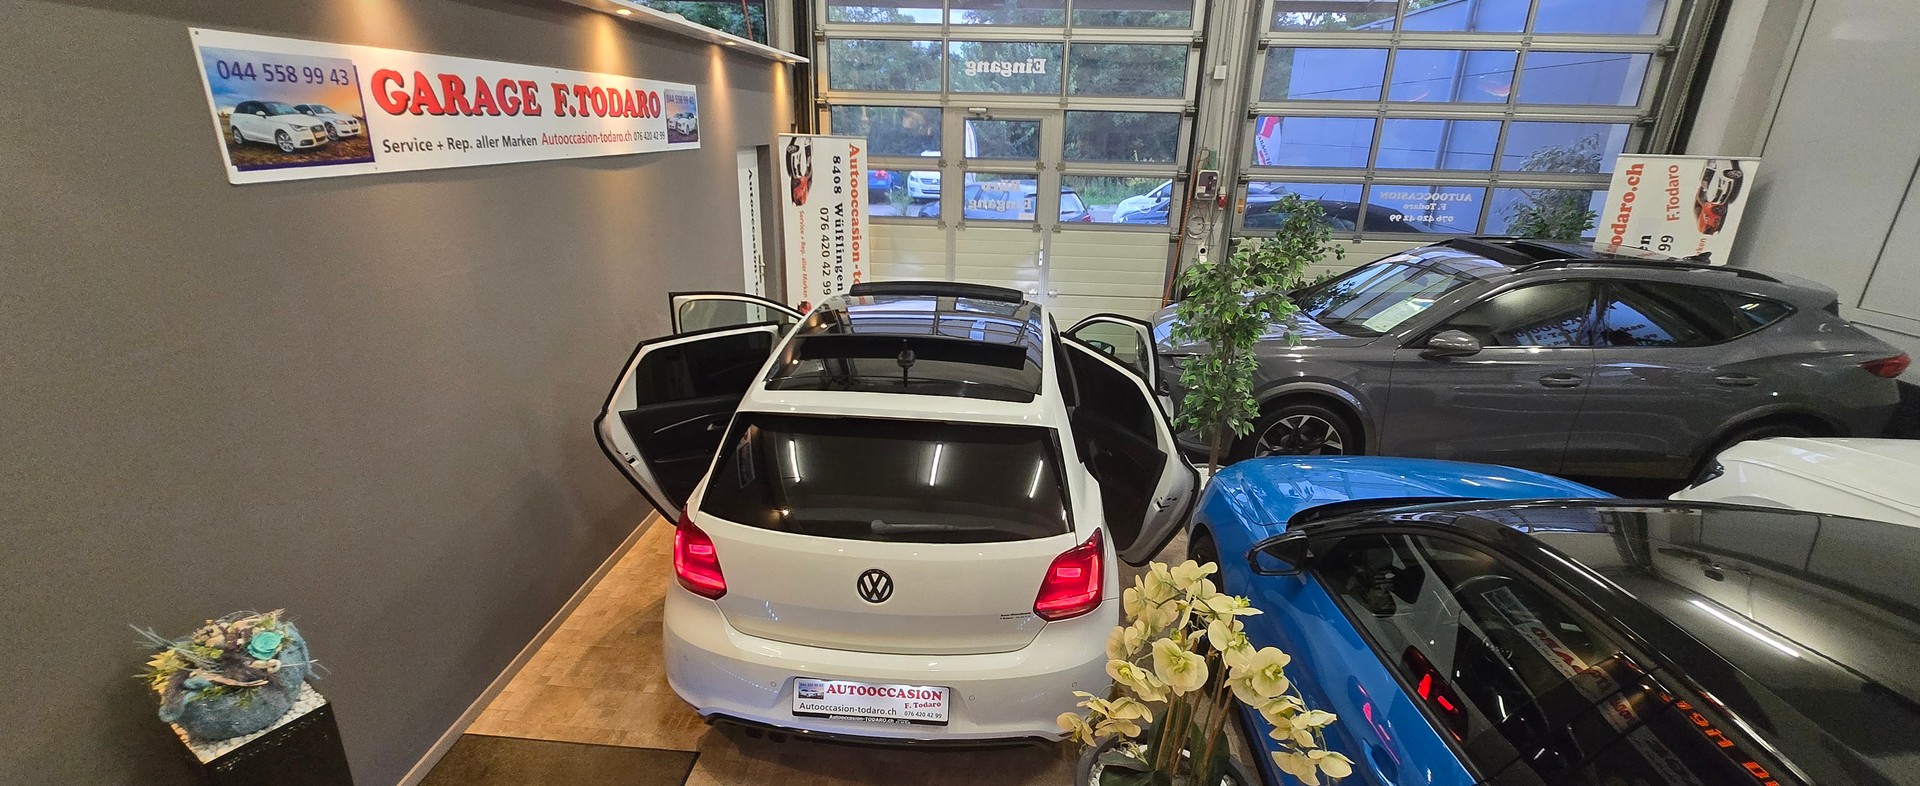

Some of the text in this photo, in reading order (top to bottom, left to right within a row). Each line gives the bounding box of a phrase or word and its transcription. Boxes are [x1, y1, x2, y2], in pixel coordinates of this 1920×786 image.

[216, 60, 349, 86] 044 558 99 43
[371, 69, 661, 119] GARAGE F.TODARO
[382, 137, 433, 153] Service
[437, 140, 444, 150] +
[447, 137, 473, 153] Rep.
[476, 134, 499, 149] aller
[502, 134, 538, 149] Marken
[541, 131, 633, 146] Autooccasion-todaro.ch
[633, 131, 643, 141] 076
[644, 131, 653, 141] 420
[653, 131, 659, 140] 42
[832, 155, 845, 292] 8408 Wülflingen
[819, 207, 832, 295] 076 420 42 99
[1658, 235, 1674, 252] 99
[826, 684, 942, 701] AUTOOCCASION
[799, 702, 897, 715] Autooccasion-todaro.ch
